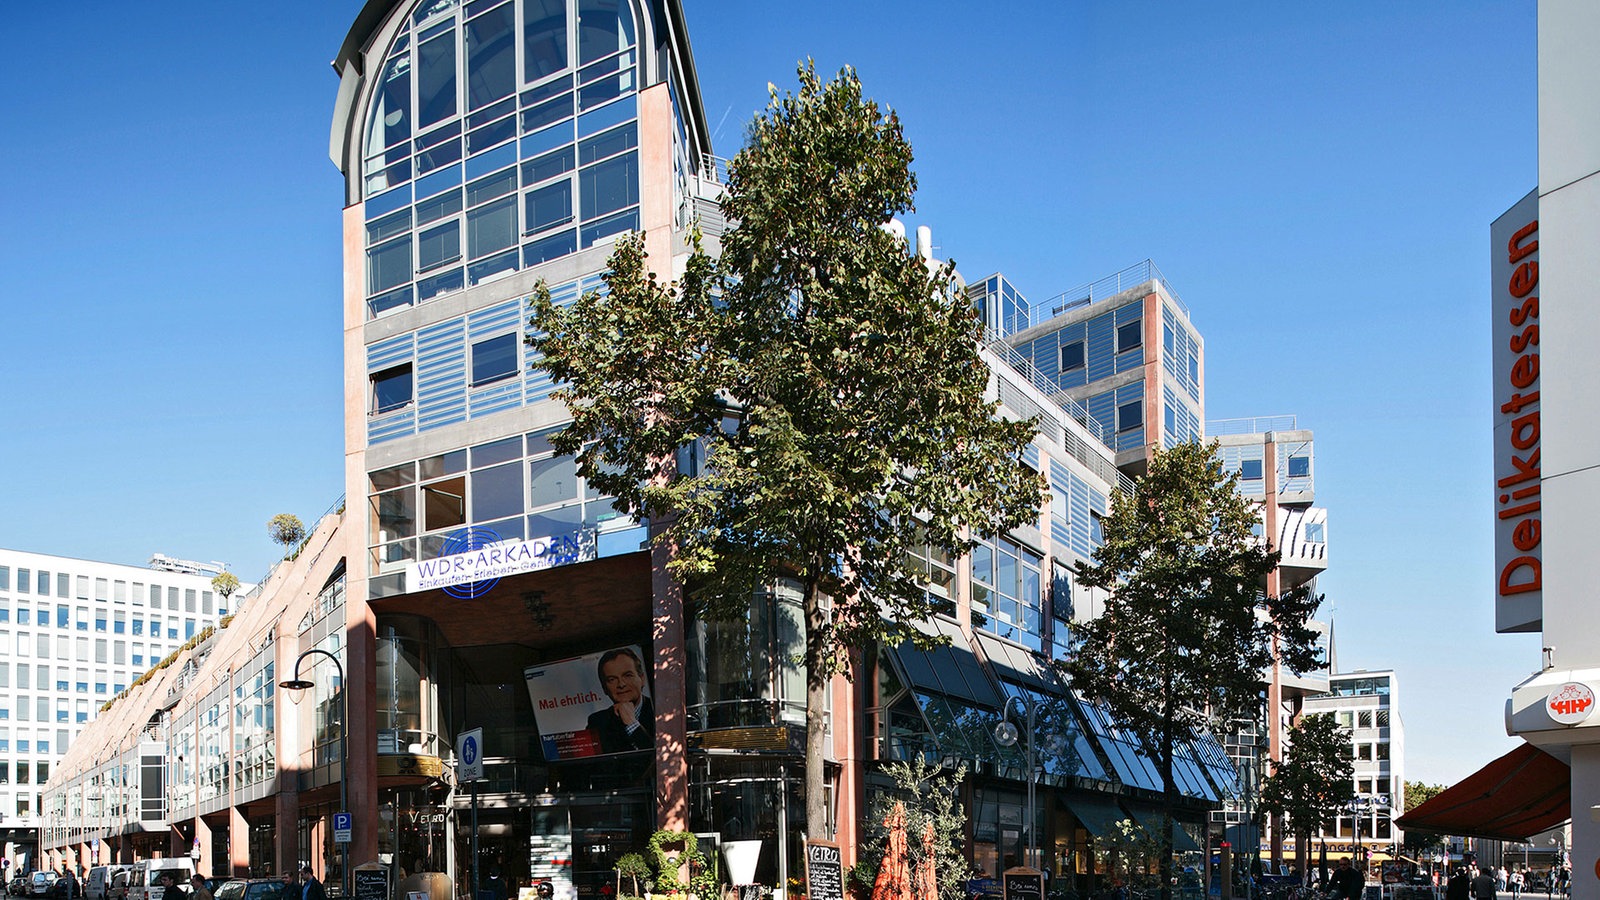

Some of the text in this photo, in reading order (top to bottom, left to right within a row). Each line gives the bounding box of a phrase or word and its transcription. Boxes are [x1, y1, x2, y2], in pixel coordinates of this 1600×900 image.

[1498, 219, 1542, 597] Delikatessen
[538, 690, 602, 711] Mal ehrlich.
[338, 815, 347, 829] P
